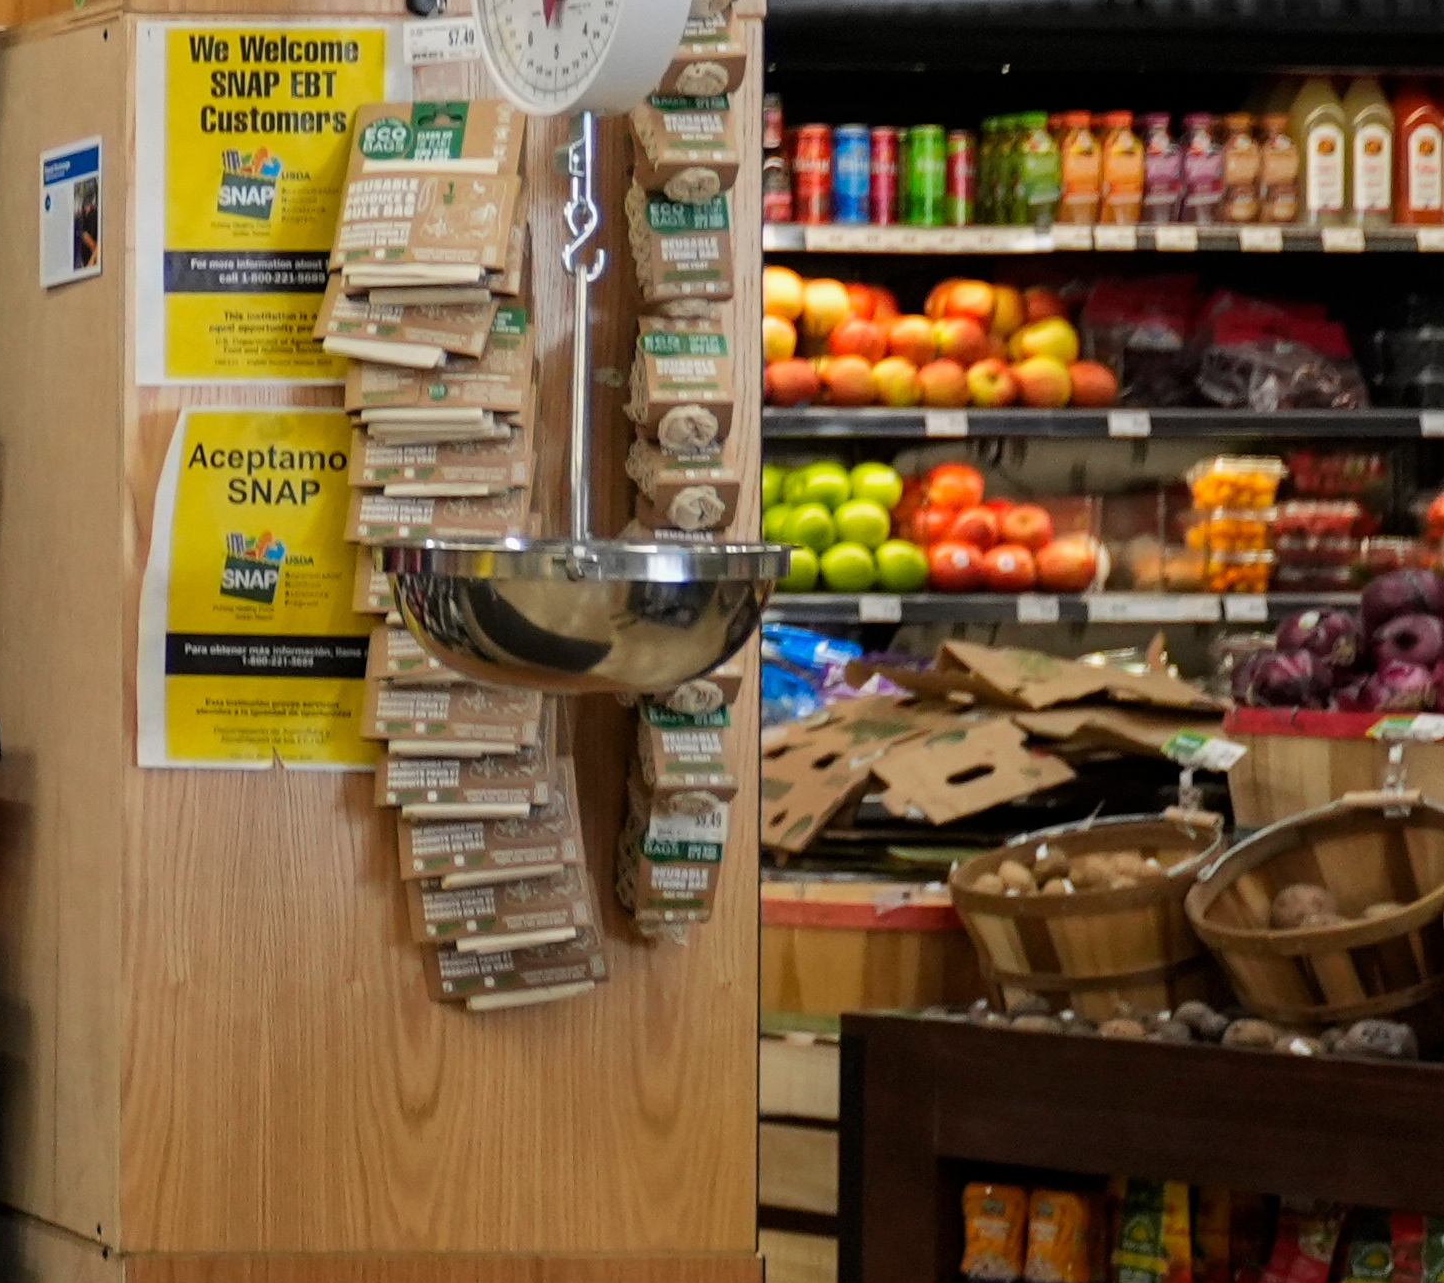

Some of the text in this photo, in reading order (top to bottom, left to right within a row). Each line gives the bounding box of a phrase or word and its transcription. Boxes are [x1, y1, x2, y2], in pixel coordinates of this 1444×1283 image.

[189, 35, 358, 64] We Welcome
[448, 30, 474, 46] $7.49
[211, 71, 337, 99] SNAP EBT
[200, 106, 347, 134] Customers
[365, 126, 407, 142] ECO
[218, 183, 275, 207] SNAP
[189, 443, 347, 476] Aceptamo
[228, 478, 320, 505] SNAP
[222, 568, 278, 589] SNAP
